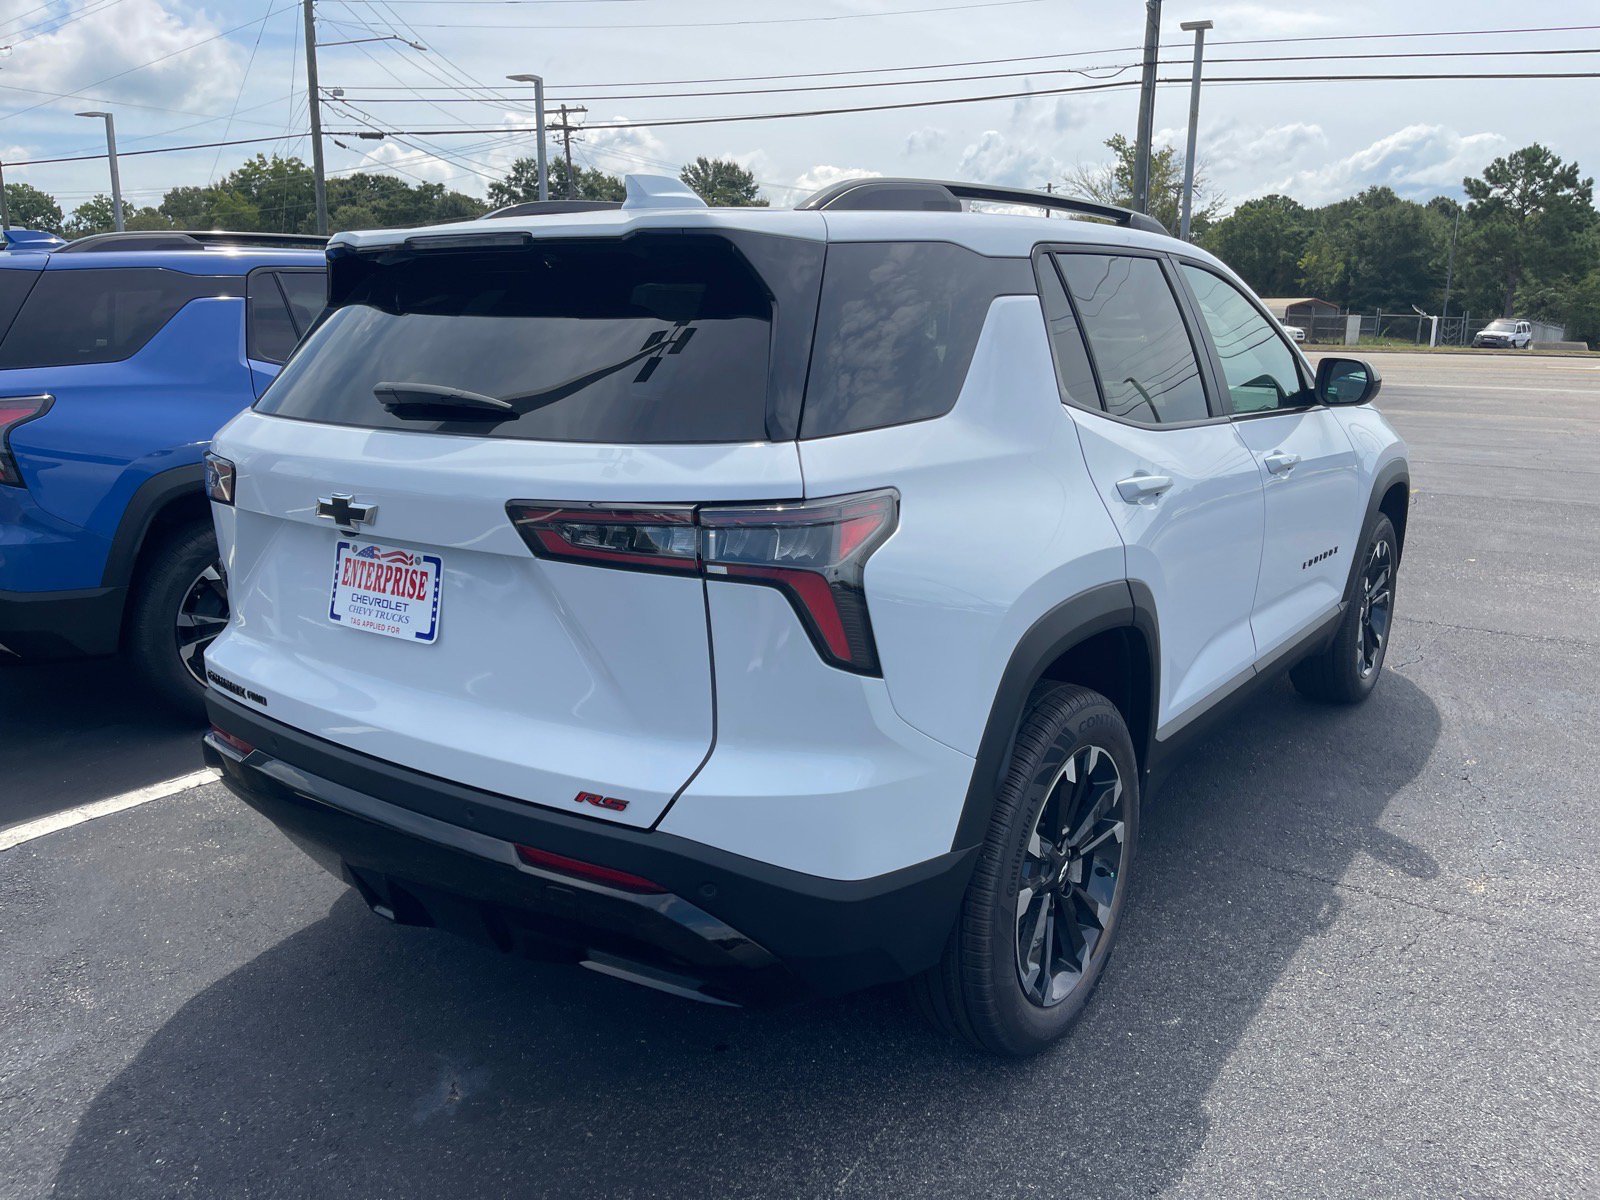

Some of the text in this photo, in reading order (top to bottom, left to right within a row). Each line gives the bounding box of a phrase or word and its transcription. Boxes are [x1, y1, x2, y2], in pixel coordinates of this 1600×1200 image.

[341, 557, 429, 602] ENTERPRISE
[351, 593, 410, 613] CHEVROLET
[348, 604, 410, 625] CHEVY TRUCKS
[350, 617, 401, 635] TAG APPLIED FOR
[574, 791, 630, 811] RS
